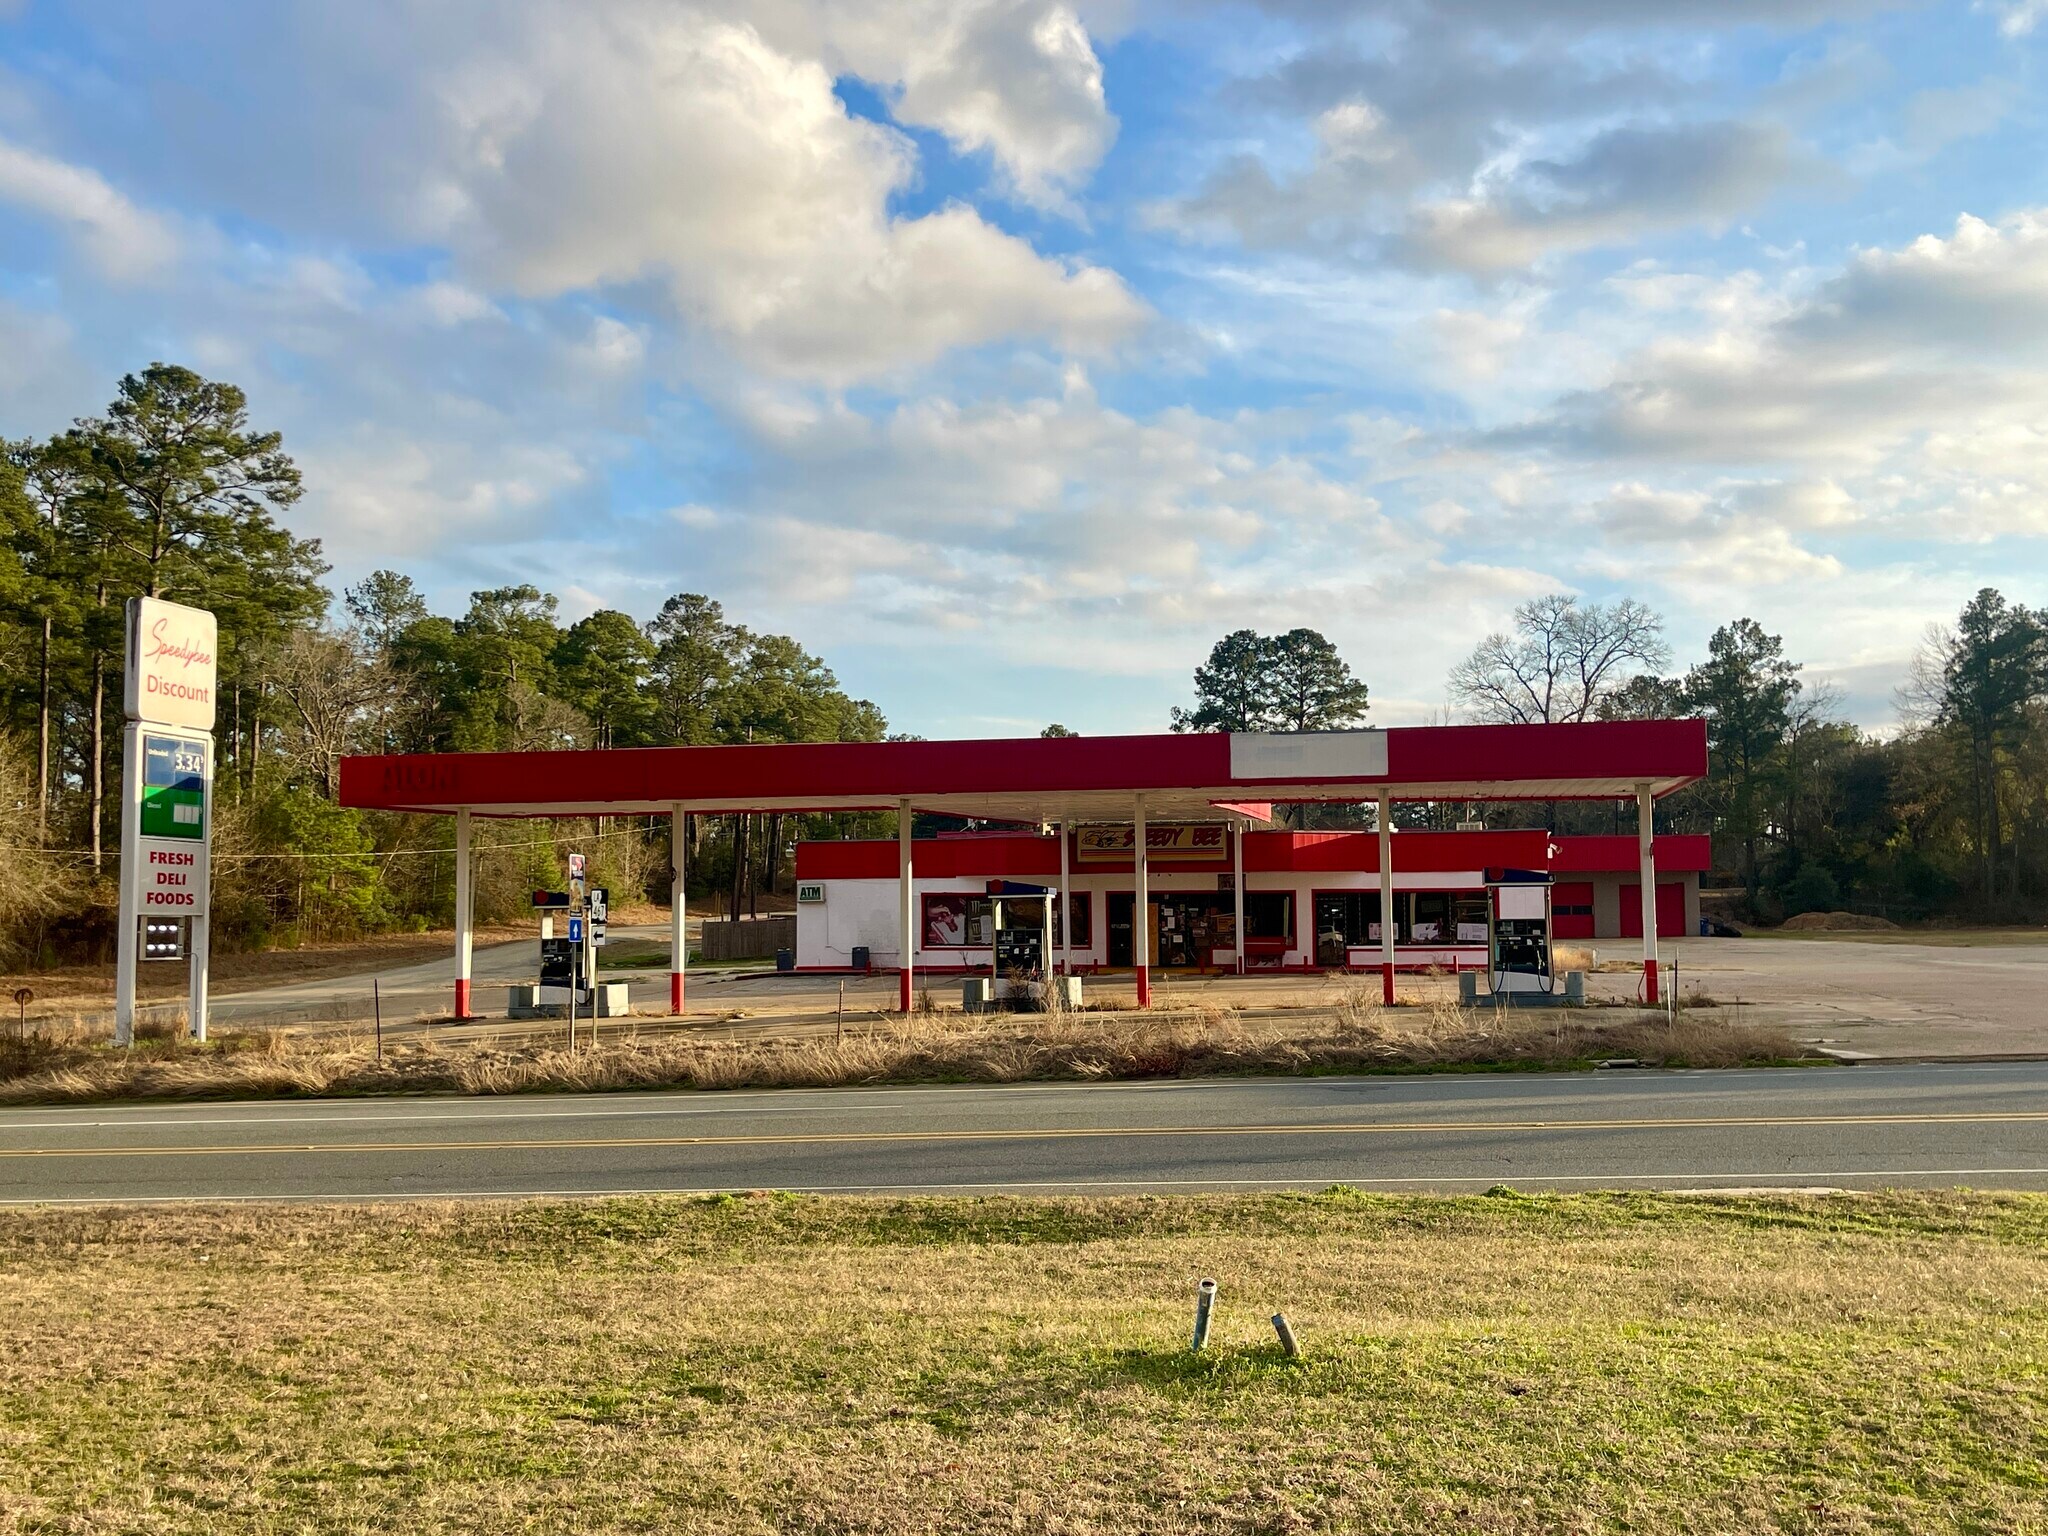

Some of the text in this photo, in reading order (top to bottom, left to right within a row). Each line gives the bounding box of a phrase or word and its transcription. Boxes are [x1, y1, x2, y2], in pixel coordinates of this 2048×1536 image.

[145, 618, 211, 668] Speedybee
[147, 675, 209, 703] Discount
[175, 753, 201, 772] 3.34
[1122, 827, 1222, 847] SEEDY BEE
[149, 851, 194, 866] FRESH
[157, 872, 186, 886] DELI
[146, 892, 194, 905] FOODS
[800, 887, 821, 899] ATM
